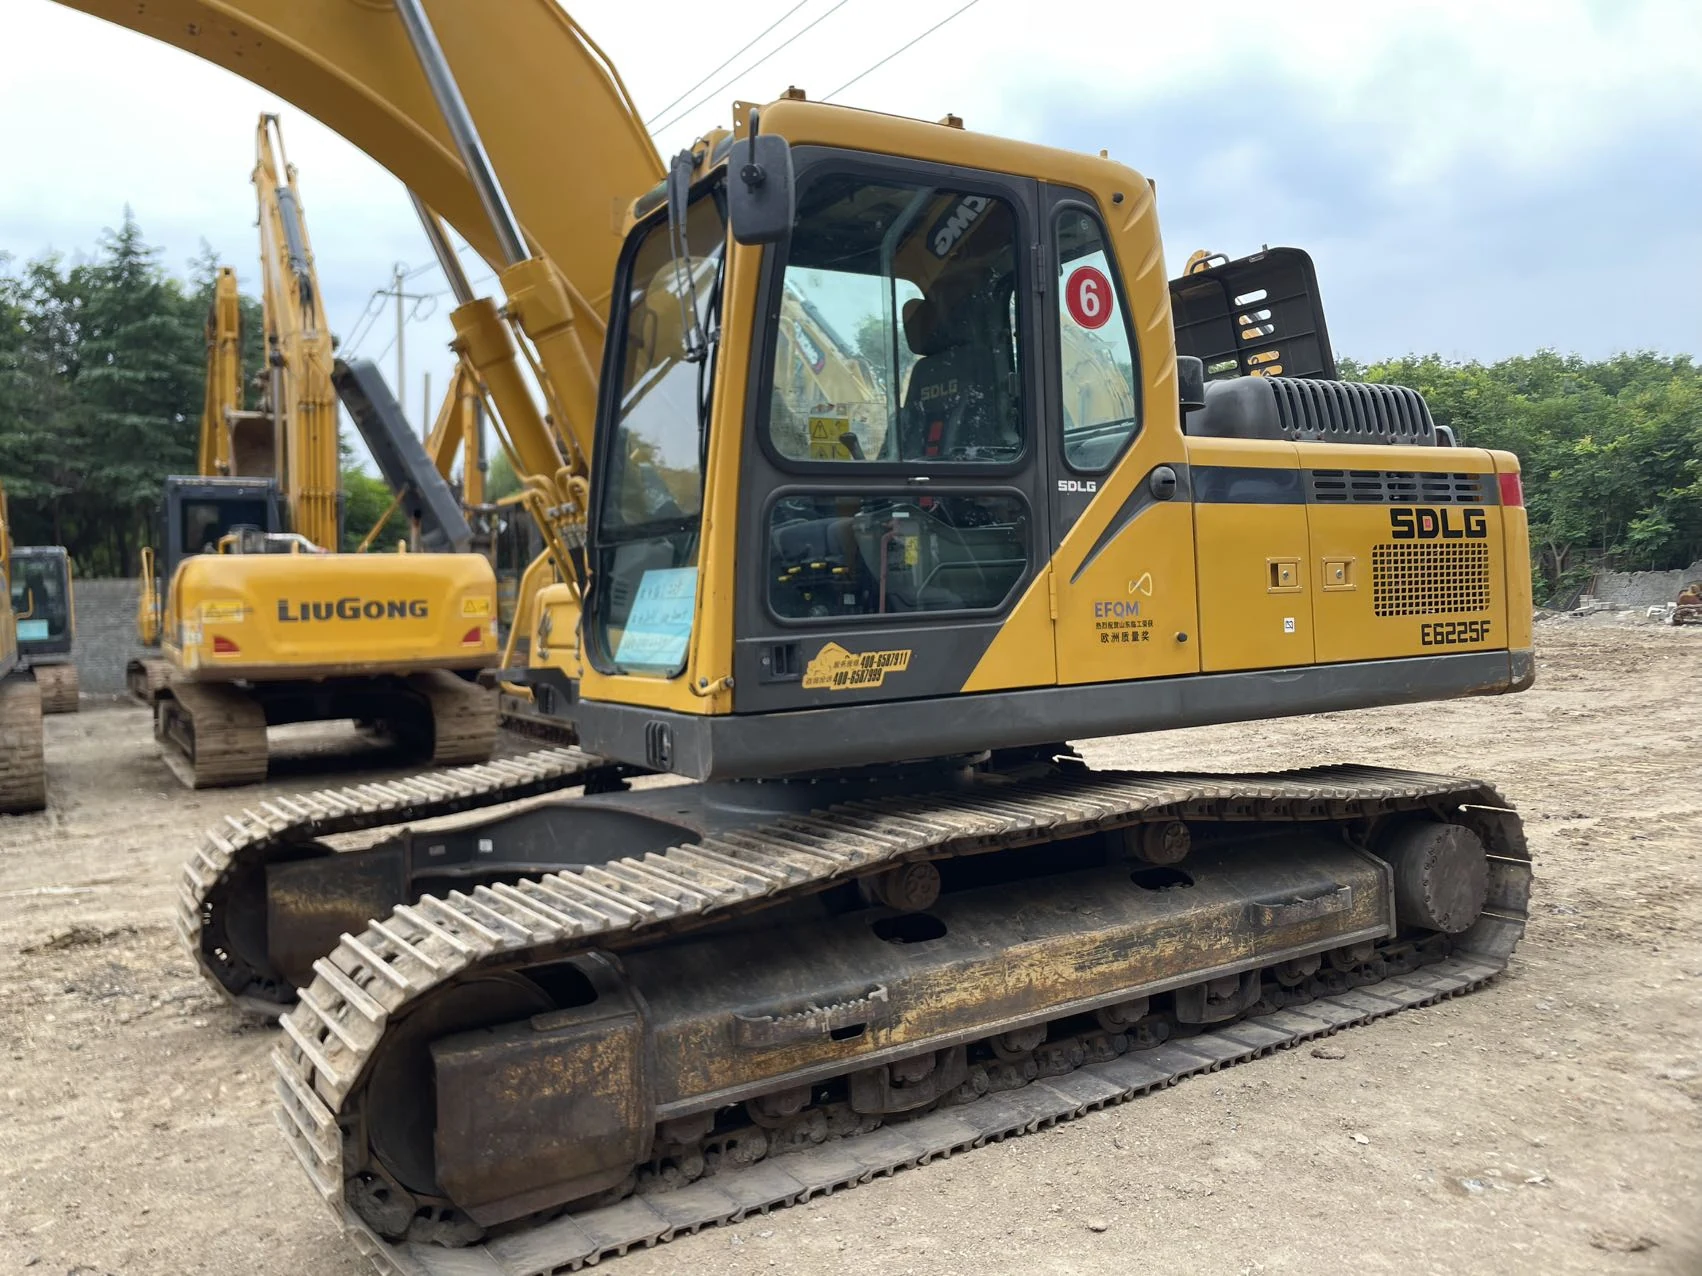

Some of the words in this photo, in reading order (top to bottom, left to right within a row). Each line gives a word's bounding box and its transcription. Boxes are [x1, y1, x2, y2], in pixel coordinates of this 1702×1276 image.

[1079, 278, 1100, 317] 6
[920, 379, 957, 401] SDLG
[1058, 480, 1096, 493] SDLG
[1390, 508, 1487, 539] SDLG
[1095, 601, 1139, 618] EFQM
[1100, 631, 1150, 643] 欧洲质量奖
[1421, 620, 1491, 645] E6225F
